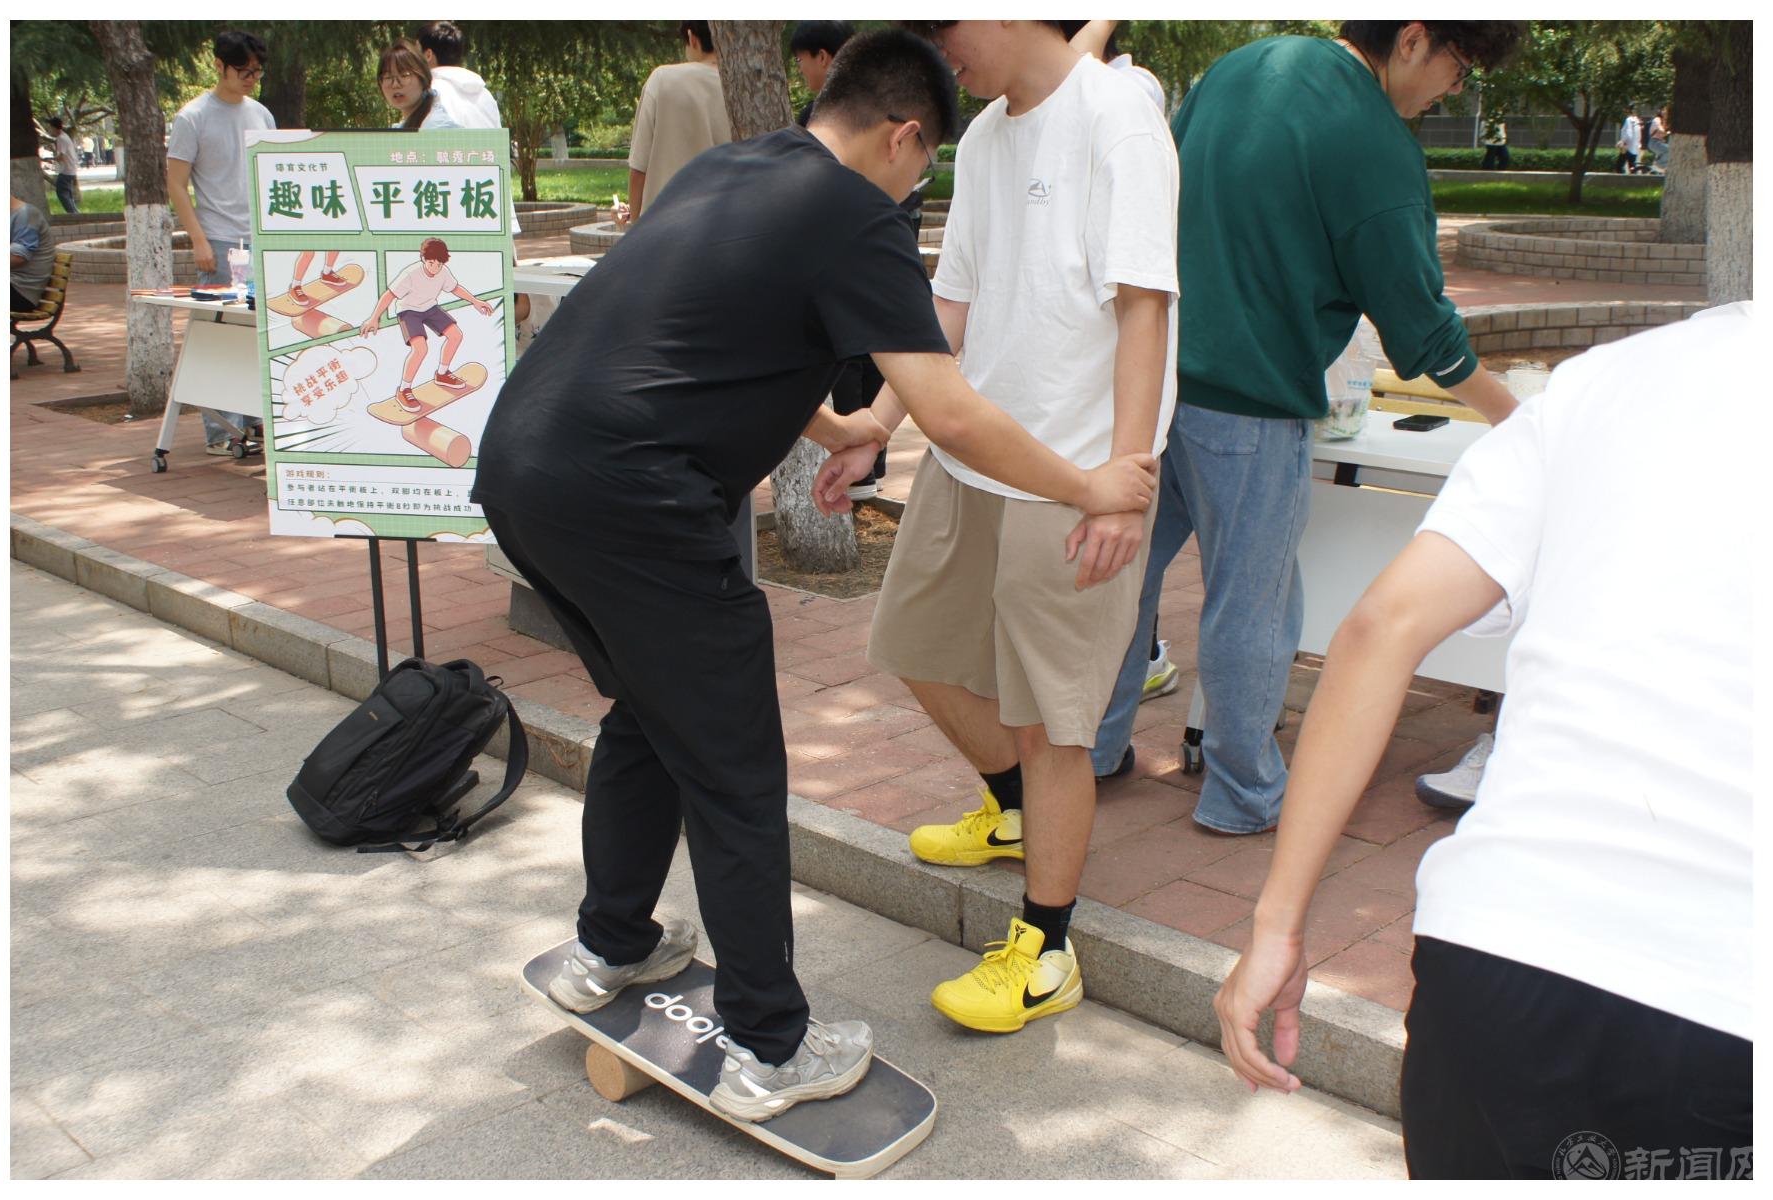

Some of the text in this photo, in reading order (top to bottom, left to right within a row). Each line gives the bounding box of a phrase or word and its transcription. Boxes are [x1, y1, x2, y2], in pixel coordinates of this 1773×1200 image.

[268, 178, 499, 219] 趣味 平衡板
[293, 358, 341, 396] 挑战平衡
[300, 370, 349, 407] 享受乐趣
